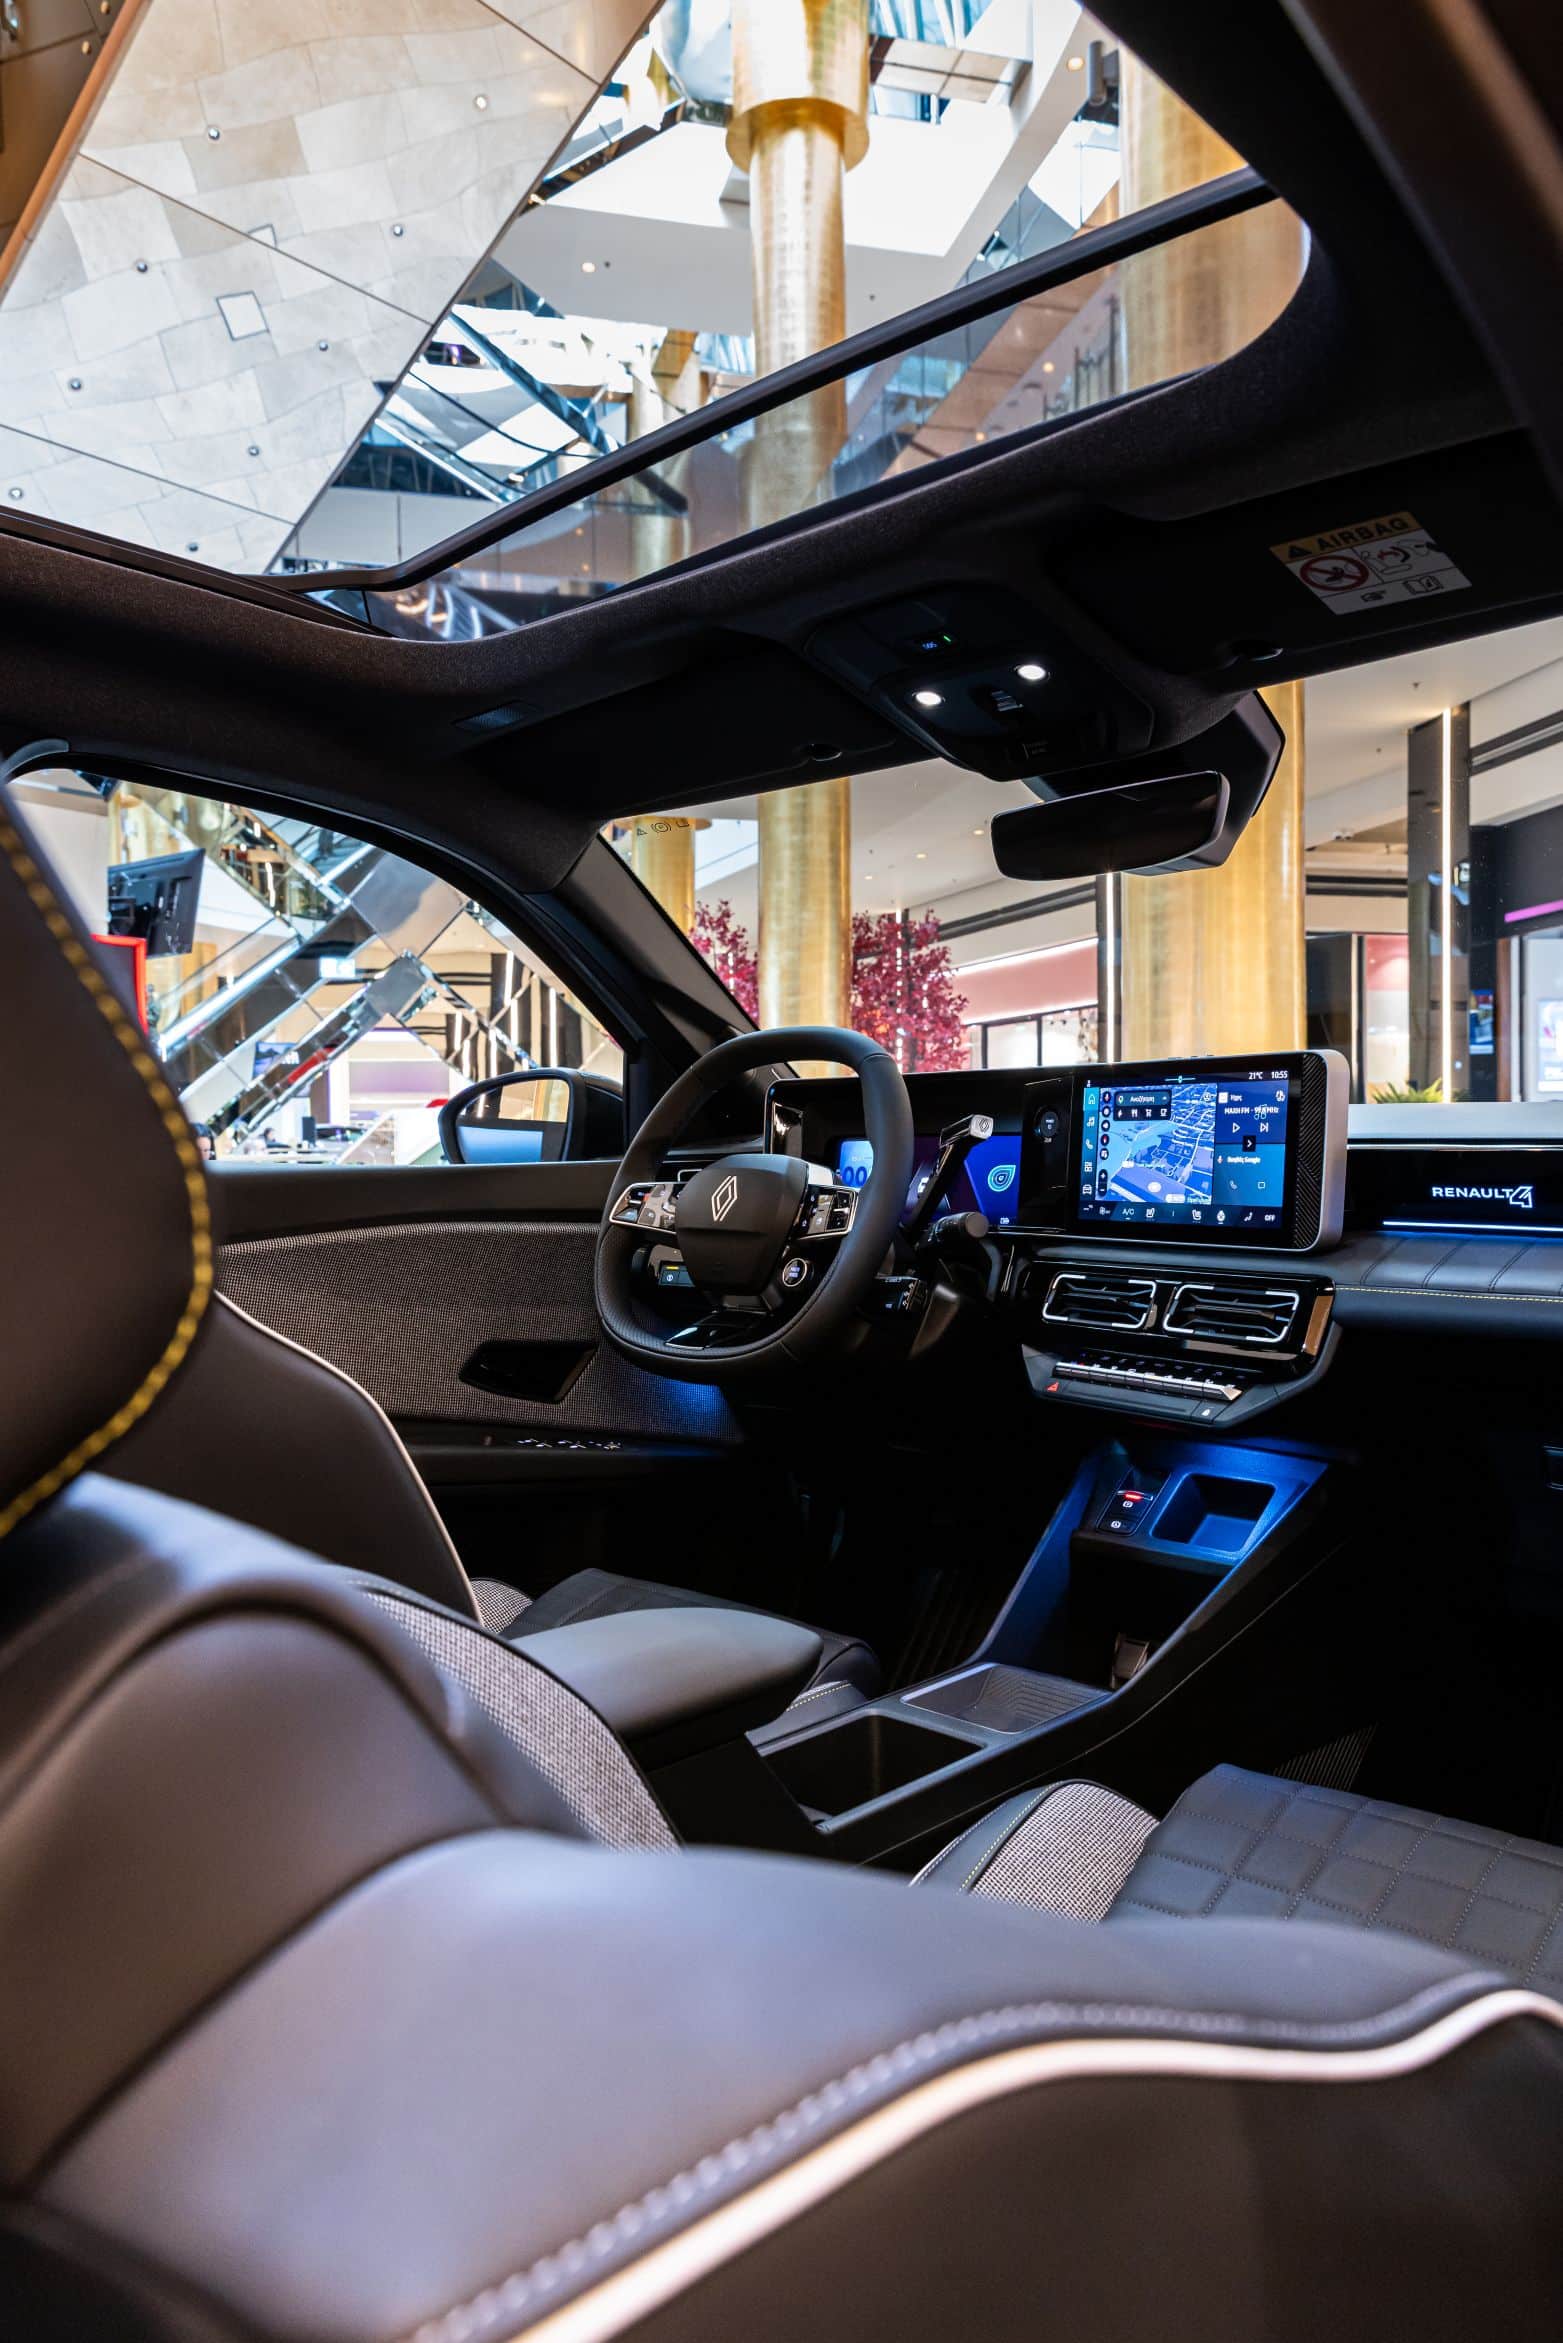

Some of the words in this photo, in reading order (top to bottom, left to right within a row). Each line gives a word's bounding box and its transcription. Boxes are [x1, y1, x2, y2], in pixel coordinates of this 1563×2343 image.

[1316, 517, 1410, 551] AIRBAG
[1248, 1071, 1263, 1080] 21°C
[1271, 1070, 1289, 1079] 10:55
[1431, 1186, 1513, 1199] RENAULT
